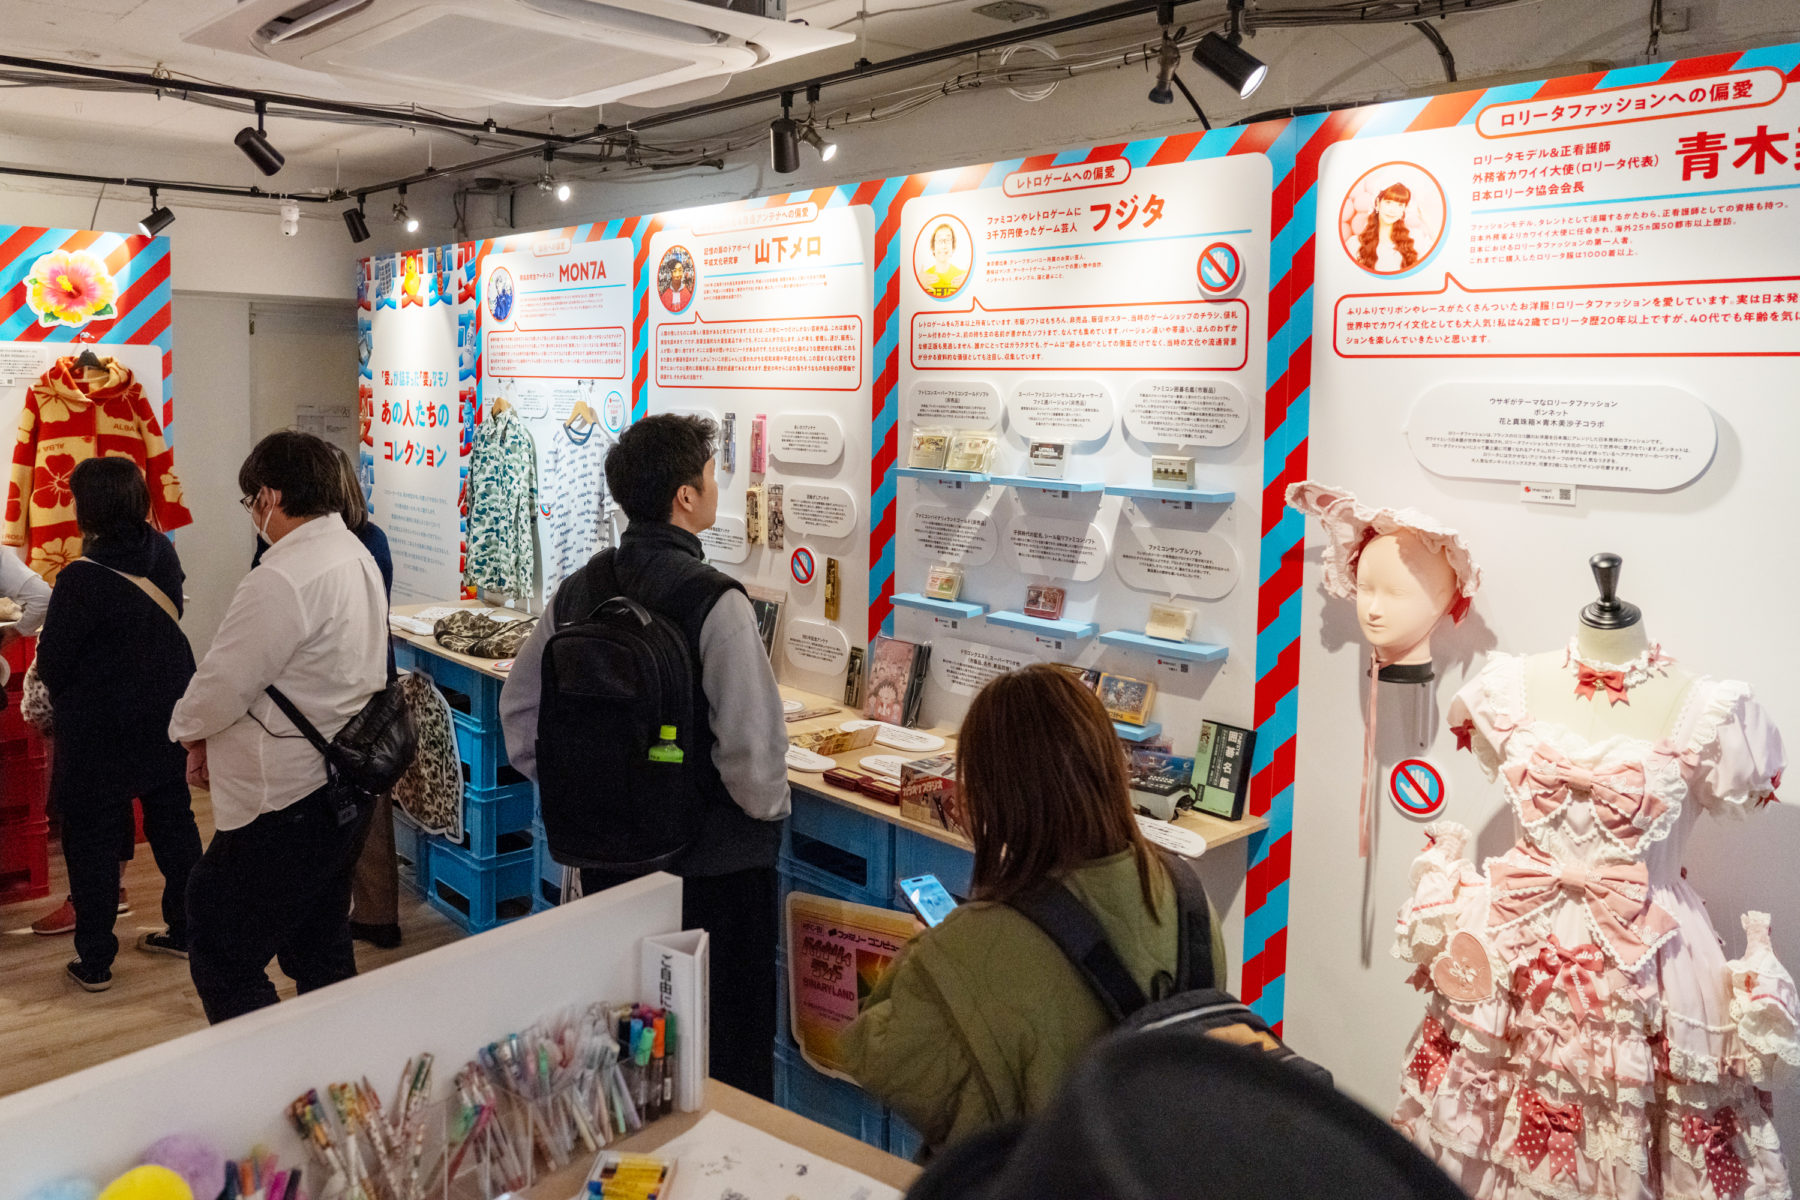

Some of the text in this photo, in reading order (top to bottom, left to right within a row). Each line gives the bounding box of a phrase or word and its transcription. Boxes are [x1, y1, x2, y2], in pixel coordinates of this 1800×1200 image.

[1500, 80, 1753, 128] ロリータファッションへの偏愛
[1473, 141, 1611, 166] ロリータモデル&正看護師
[1675, 124, 1800, 181] 青木
[1017, 165, 1115, 190] レトロゲームへの偏愛
[1472, 155, 1660, 185] 外務省カワイイ大使（ロリータ代表）
[1472, 181, 1585, 202] 日本ロリータ協会会長
[987, 207, 1081, 225] ファミコンやレトロゲームに
[1090, 194, 1166, 232] フジタ
[986, 222, 1078, 241] 3千万円使ったゲーム芸人
[754, 235, 822, 265] 山下メロ
[559, 261, 607, 283] MON7A
[1345, 334, 1491, 345] ションを楽しんでいきたいと思います。
[381, 399, 449, 428] あの人たちの
[1489, 397, 1619, 408] ウサギがテーマなロリータファッション
[1534, 408, 1569, 418] ボンネット
[113, 423, 136, 432] ALBA
[383, 439, 448, 468] コレクション
[867, 937, 901, 953] コンピュー
